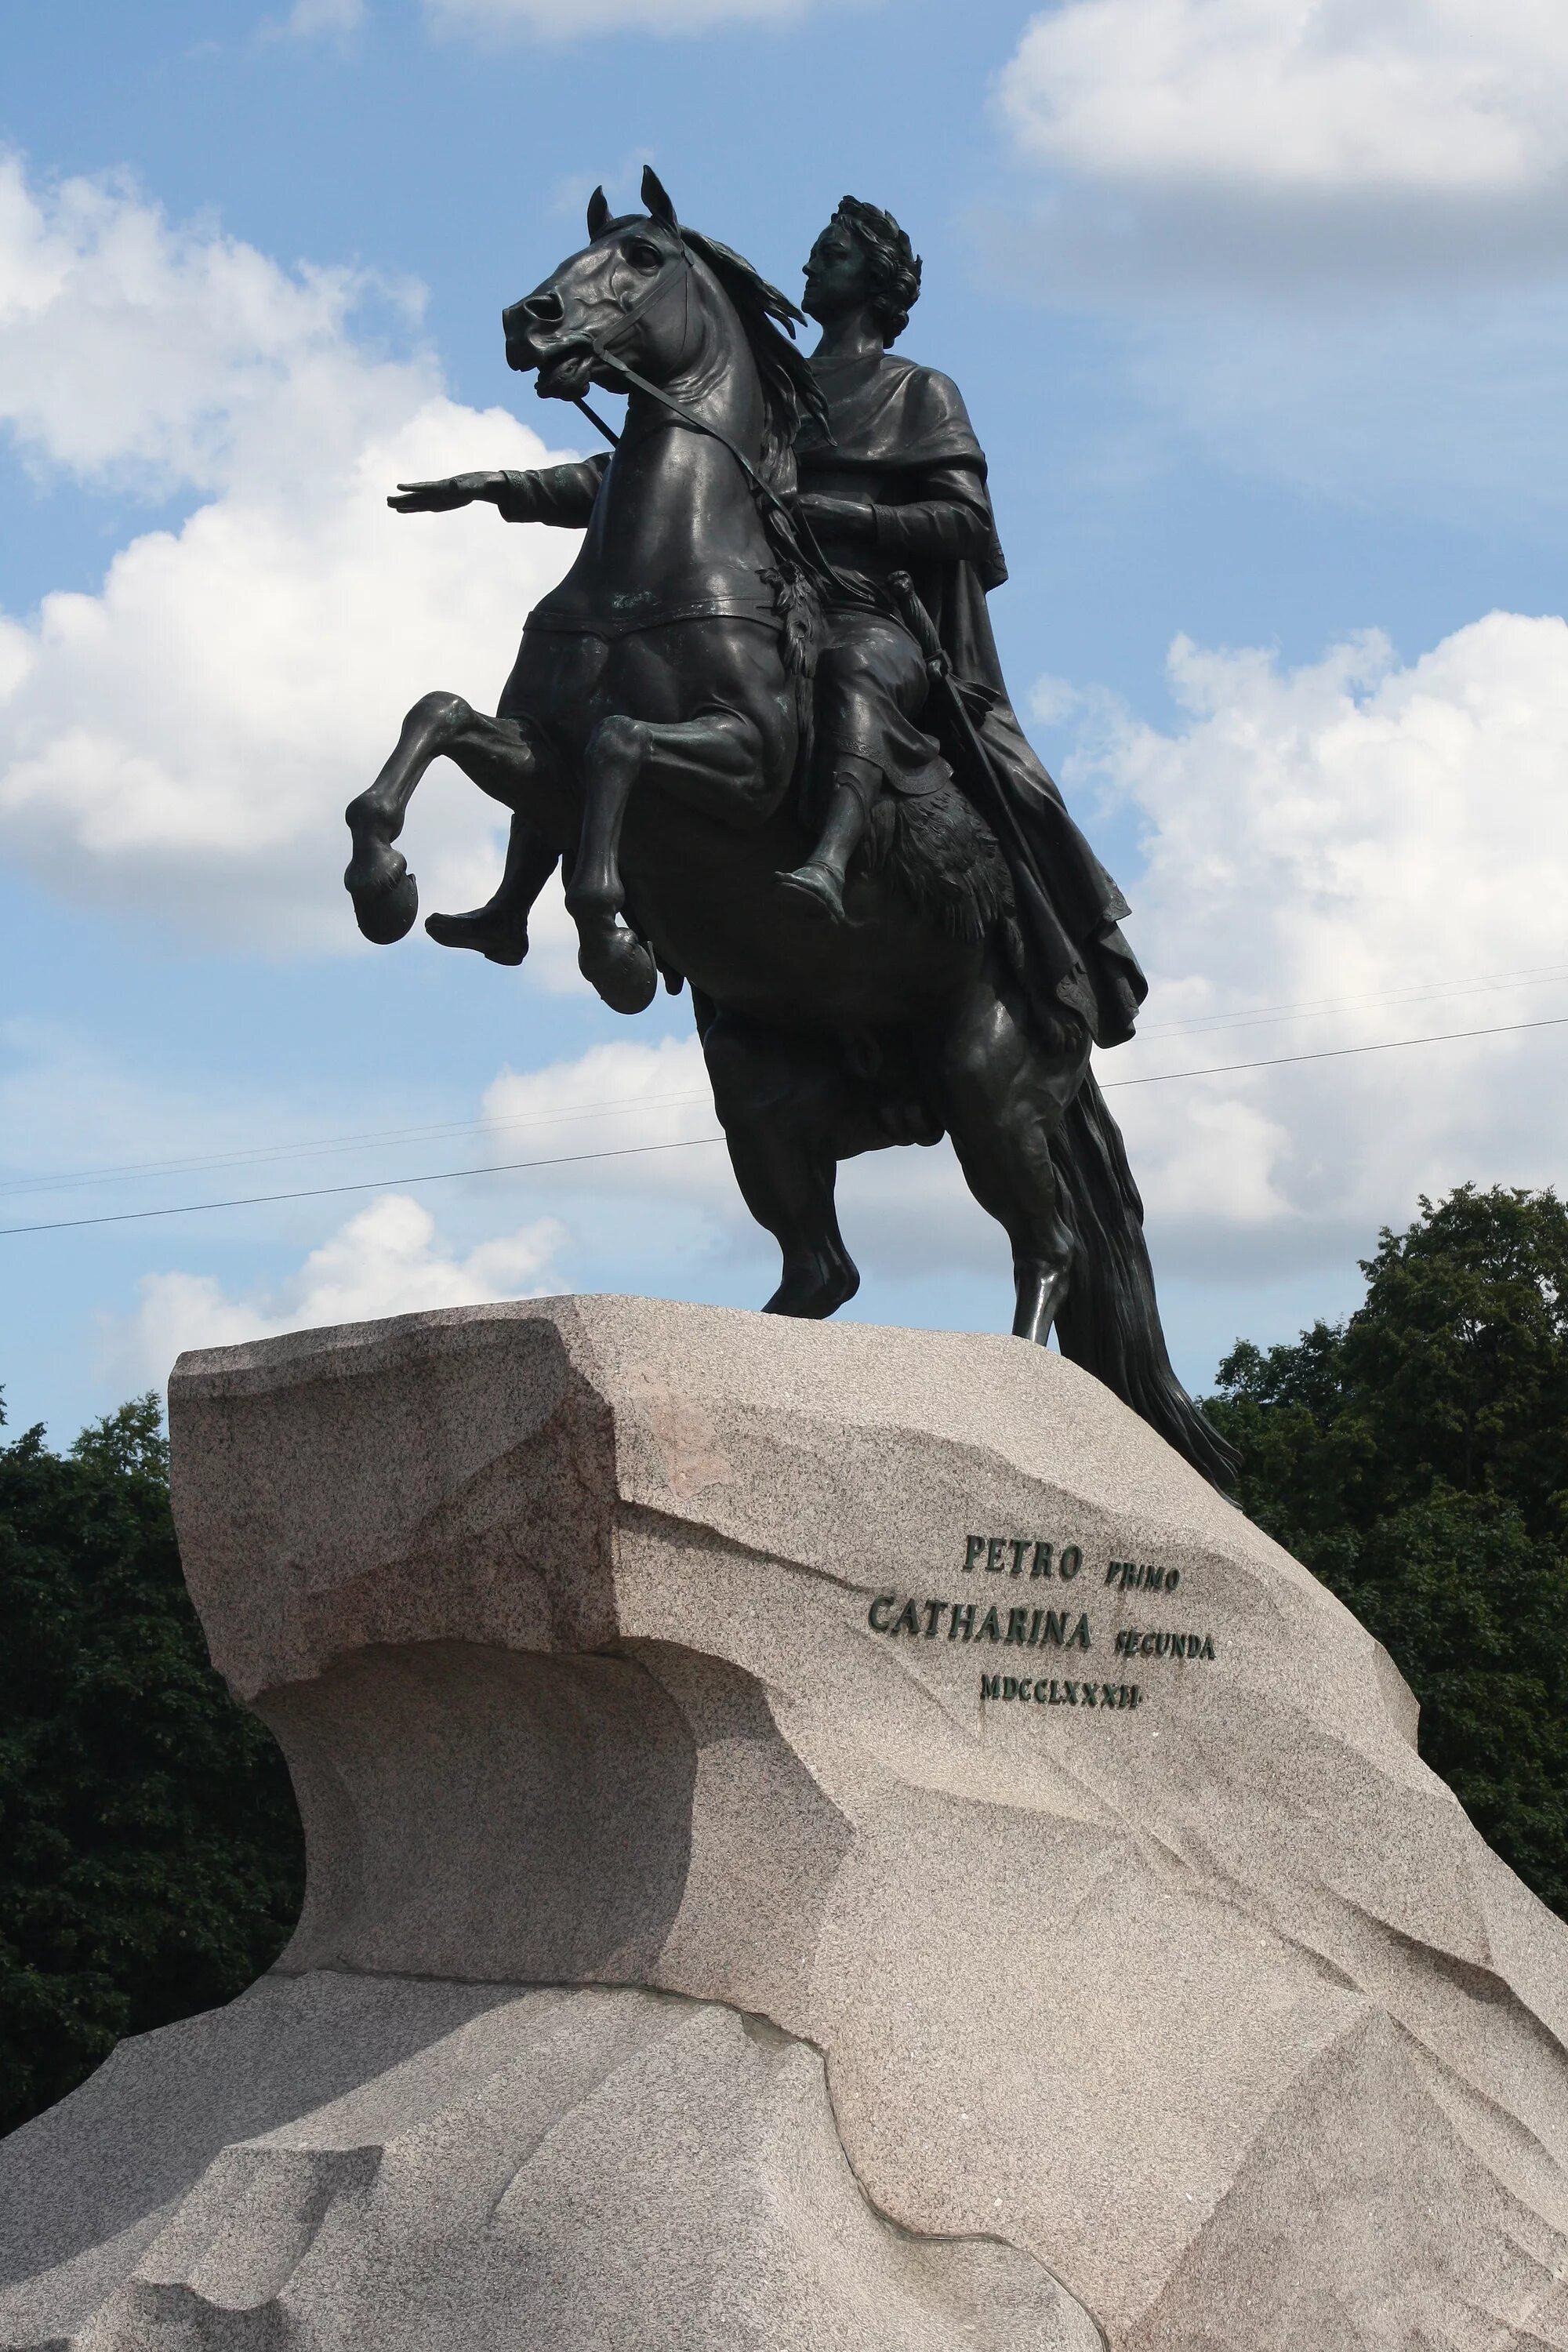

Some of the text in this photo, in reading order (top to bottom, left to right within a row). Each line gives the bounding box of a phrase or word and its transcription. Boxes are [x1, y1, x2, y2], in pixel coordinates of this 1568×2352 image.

[964, 1534, 1181, 1592] PETRO PRIMO
[868, 1595, 1217, 1660] CATHARINA SECUNDA
[980, 1674, 1142, 1708] MDCCLXXXII
